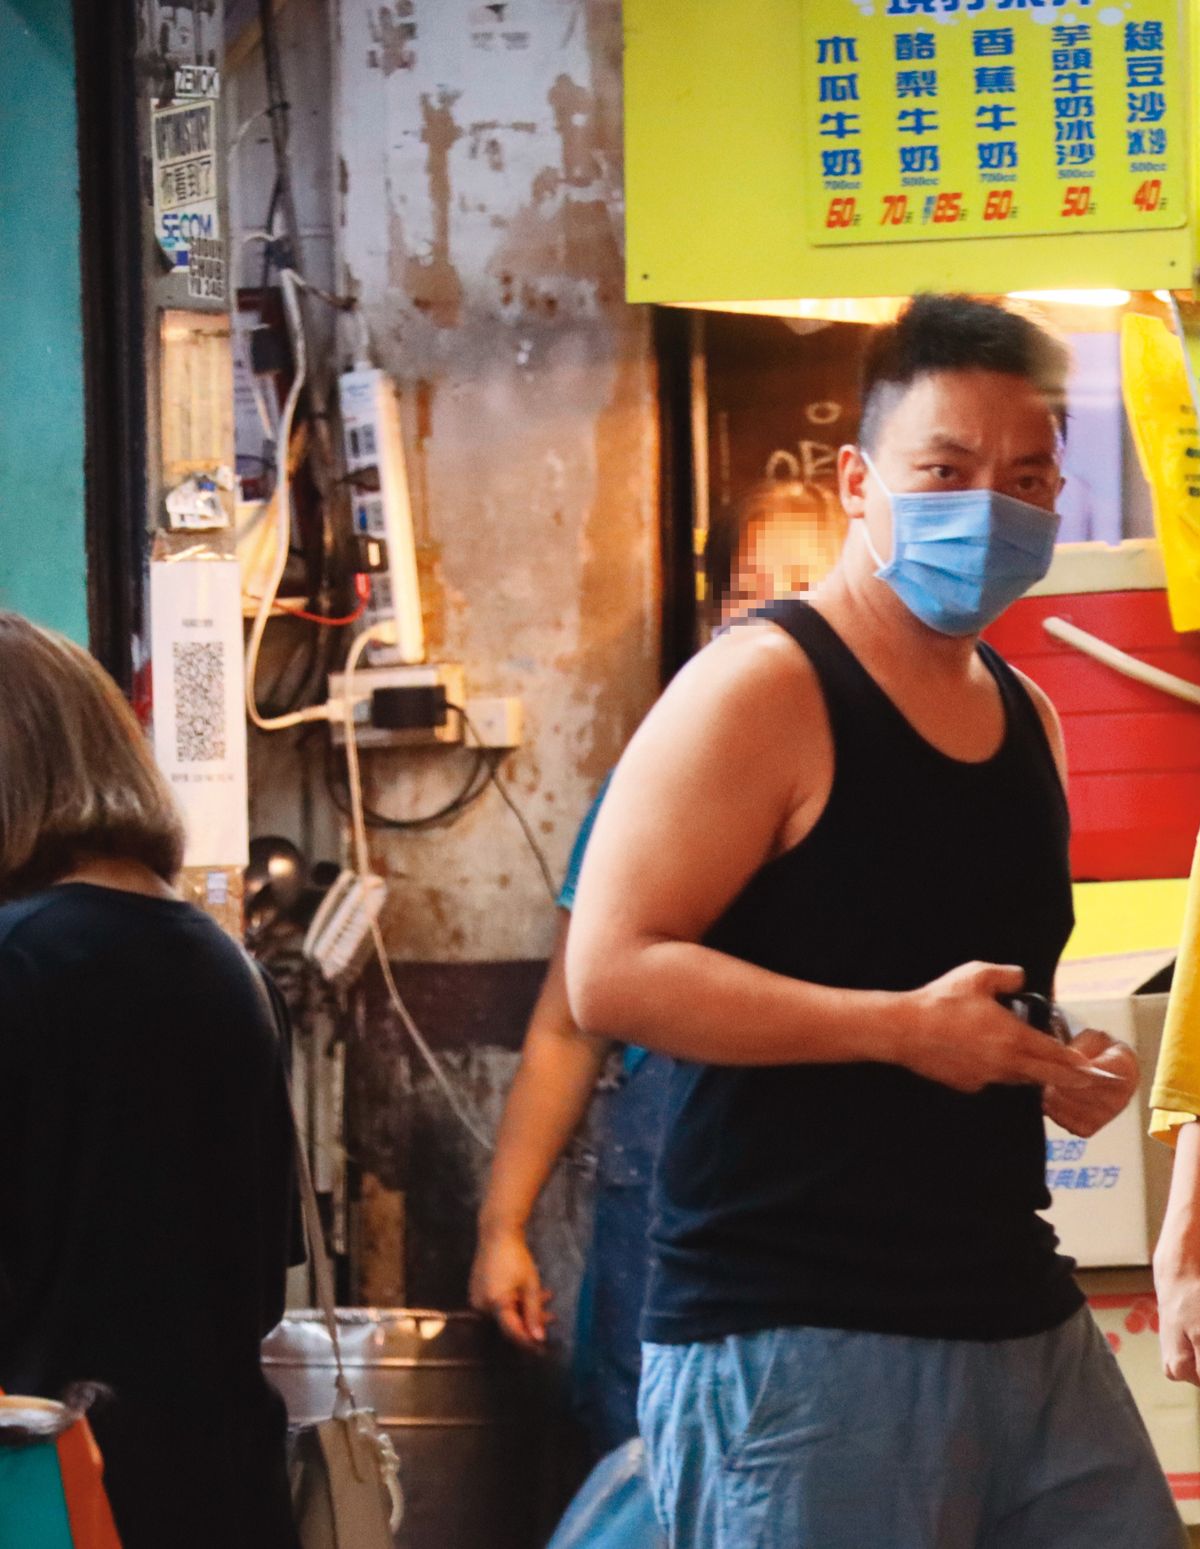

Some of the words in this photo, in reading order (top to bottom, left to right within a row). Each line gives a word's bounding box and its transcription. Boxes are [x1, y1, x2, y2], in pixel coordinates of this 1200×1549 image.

[816, 36, 862, 176] 木瓜牛奶
[894, 32, 940, 173] 酪梨牛奶
[972, 27, 1018, 169] 香蕉牛奶
[1051, 24, 1096, 166] 芋頭牛奶冰沙
